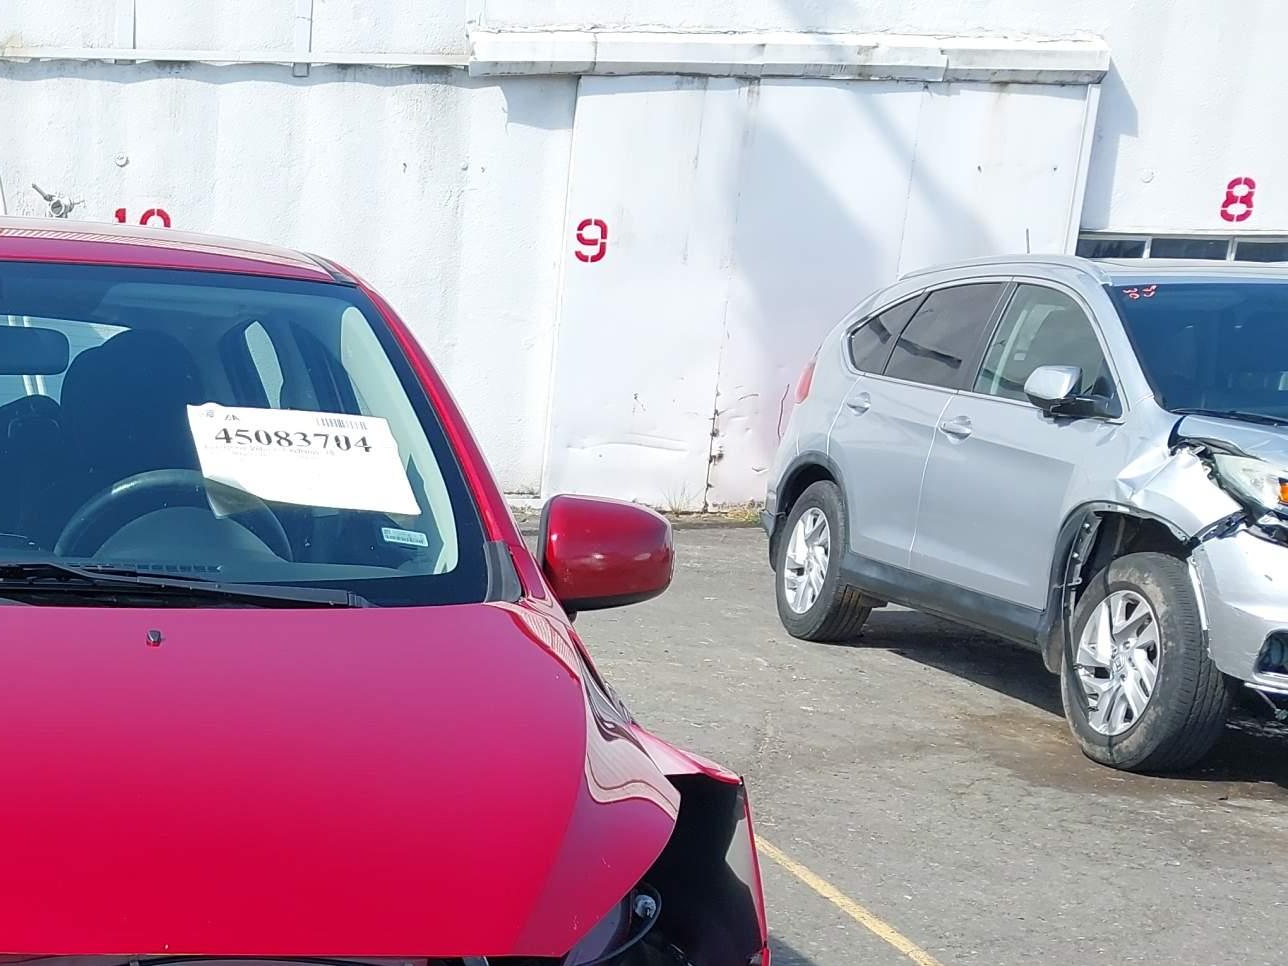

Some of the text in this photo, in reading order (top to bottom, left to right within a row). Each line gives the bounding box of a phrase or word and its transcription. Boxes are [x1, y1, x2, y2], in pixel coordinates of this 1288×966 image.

[1220, 177, 1257, 222] 8
[575, 219, 608, 262] 9
[214, 428, 372, 453] 45083704
